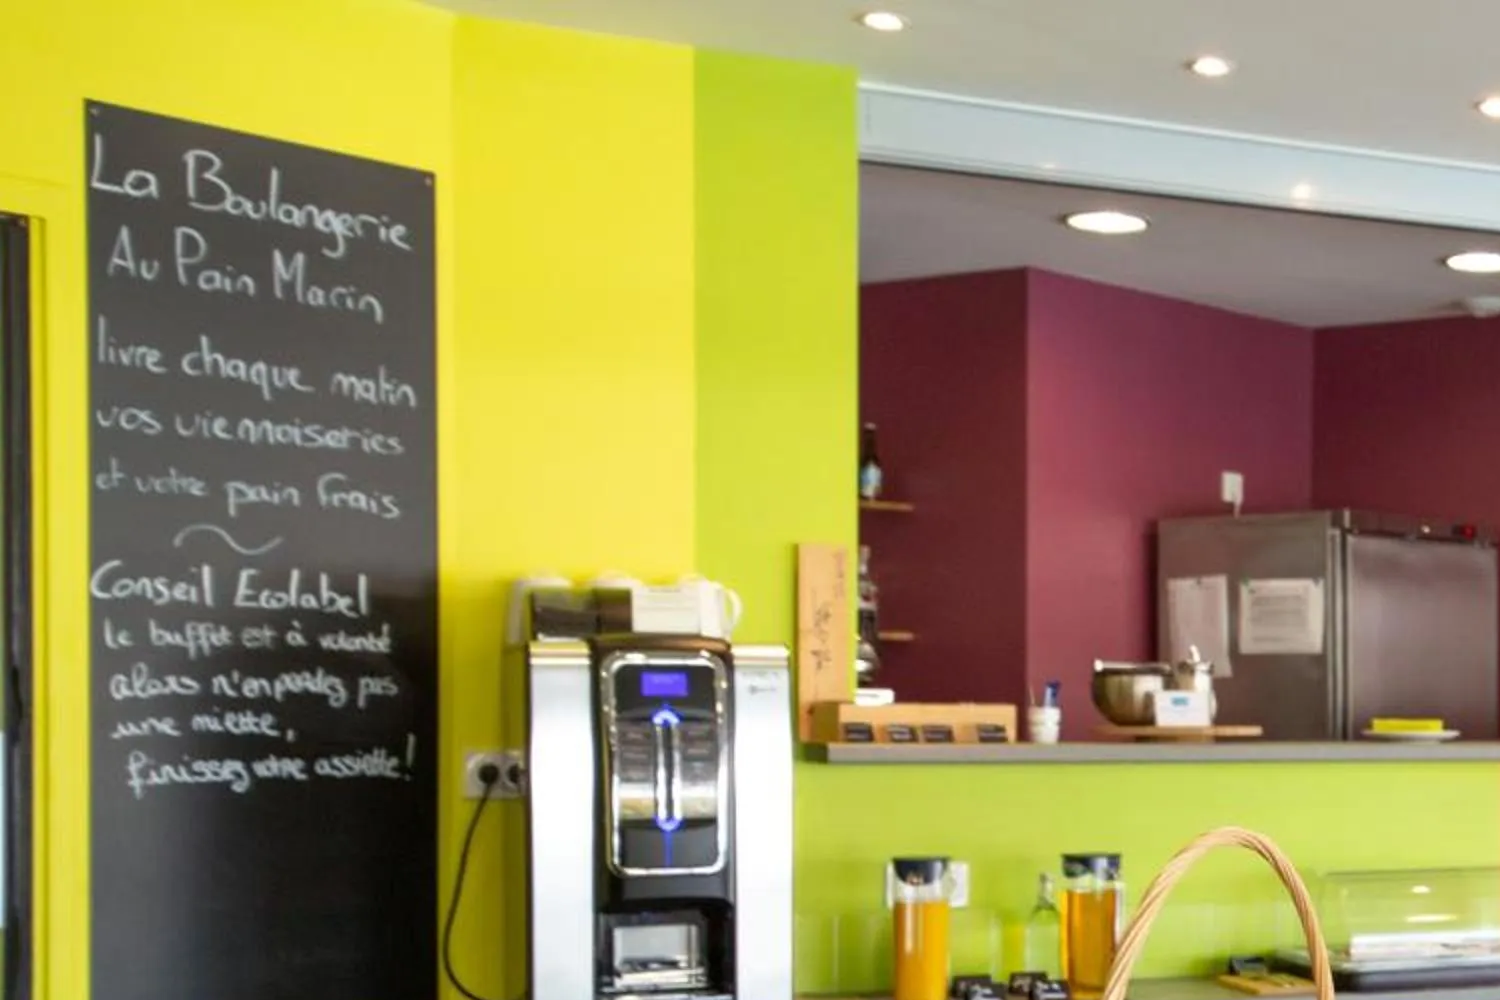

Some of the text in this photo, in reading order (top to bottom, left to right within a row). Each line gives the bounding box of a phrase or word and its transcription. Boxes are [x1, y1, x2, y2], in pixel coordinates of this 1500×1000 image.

[91, 133, 415, 259] La Boulangerie
[107, 225, 384, 325] Au Pain Marin
[97, 314, 418, 408] livre chaque matin
[96, 406, 163, 436] vos
[95, 457, 126, 491] et
[133, 467, 208, 497] votre
[224, 480, 301, 518] pain
[90, 559, 369, 619] Conseil Ecolabel
[103, 618, 393, 661] le buffet est à volonté
[109, 661, 201, 701] alors
[357, 673, 400, 710] pas
[109, 715, 182, 740] une
[126, 751, 251, 800] finissez
[252, 752, 309, 782] votre
